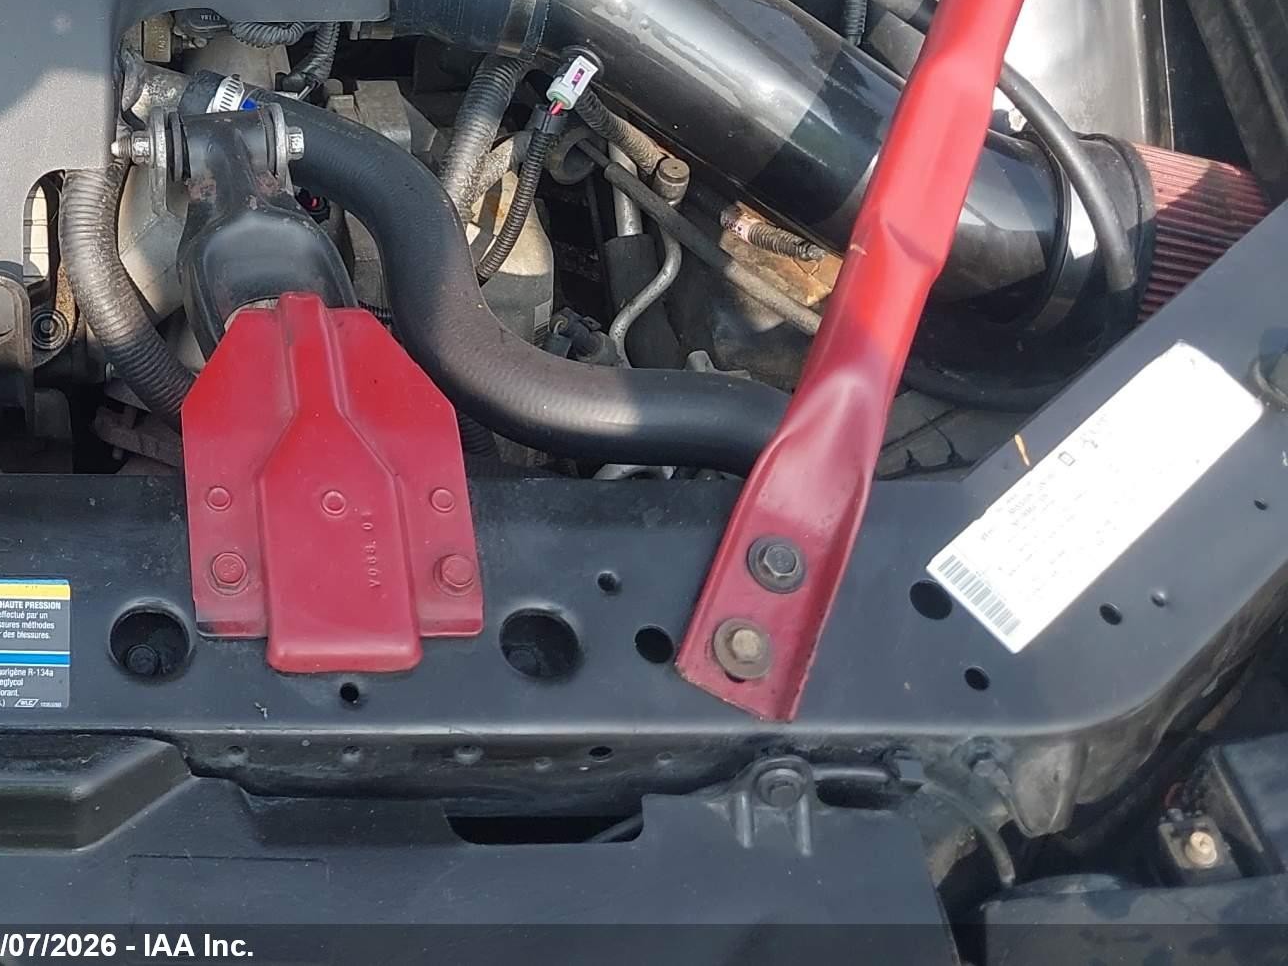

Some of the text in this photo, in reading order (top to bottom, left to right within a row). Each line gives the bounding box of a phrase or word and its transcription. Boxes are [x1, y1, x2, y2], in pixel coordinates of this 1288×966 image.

[0, 600, 23, 609] HAUTE
[25, 601, 61, 610] PRESSION
[0, 610, 24, 618] effectué
[26, 611, 38, 619] par
[22, 621, 55, 629] méthodes
[3, 630, 15, 638] des
[17, 631, 50, 639] blessures.
[28, 668, 54, 677] R-134a
